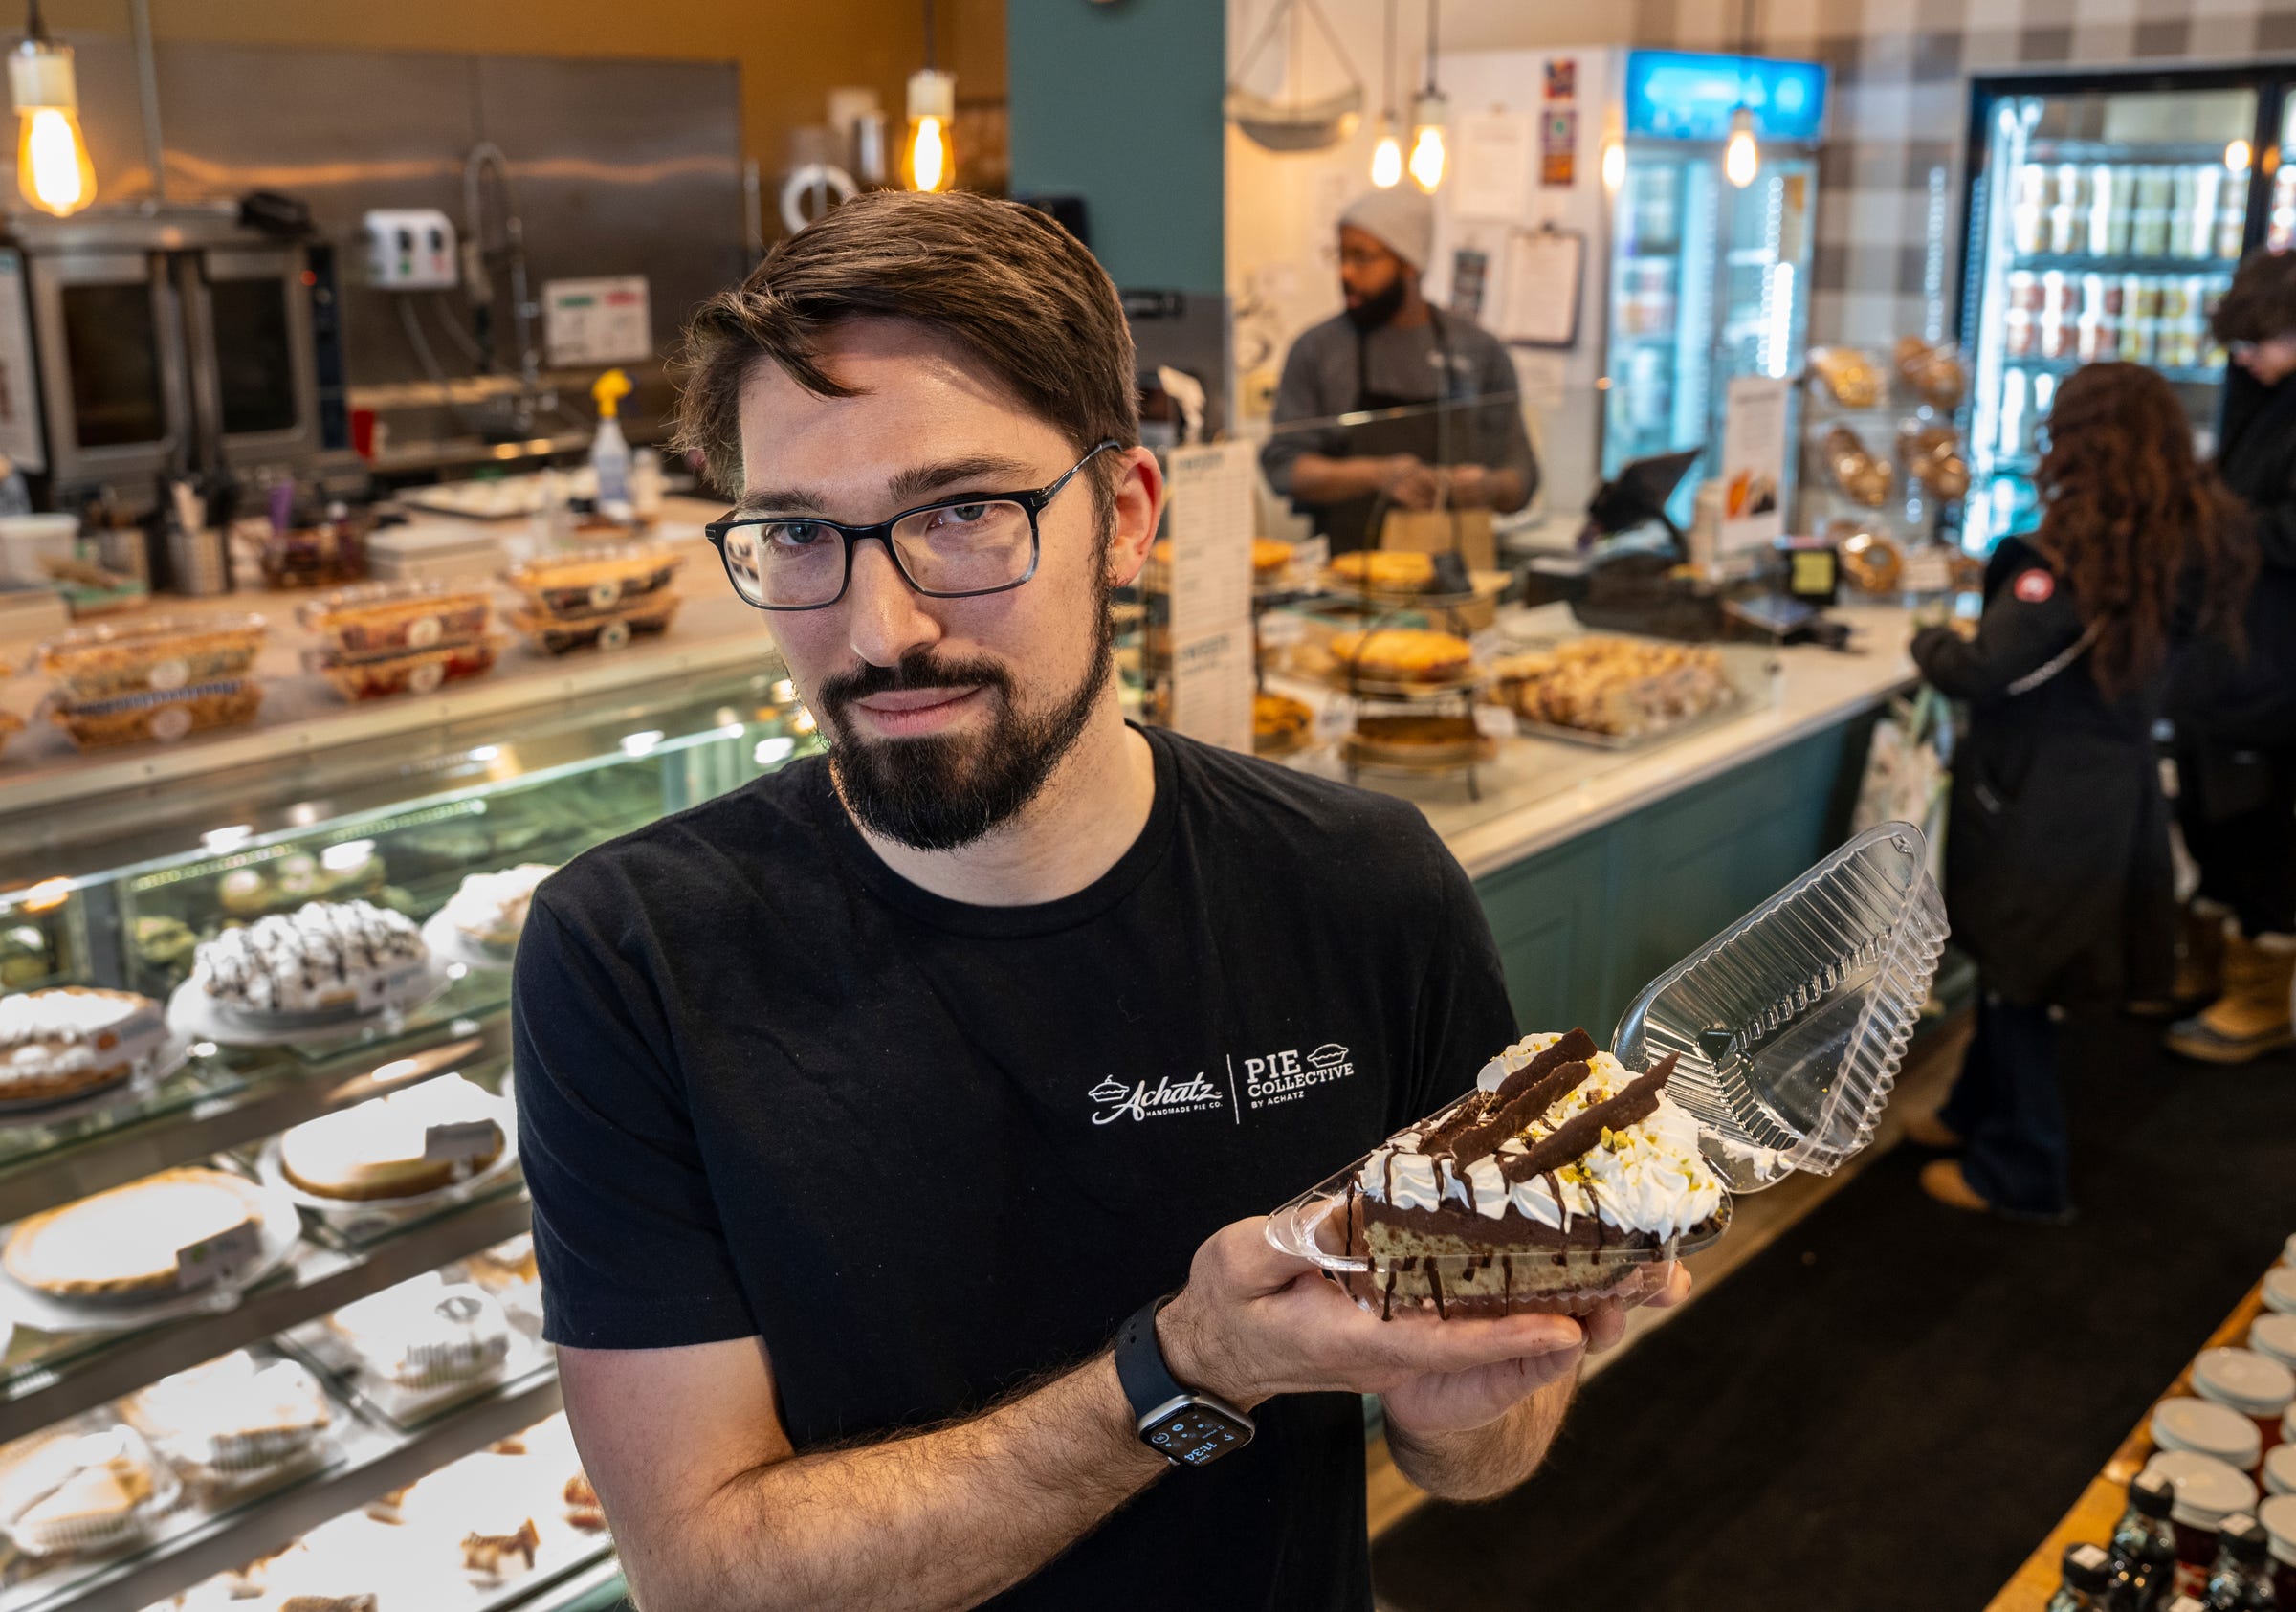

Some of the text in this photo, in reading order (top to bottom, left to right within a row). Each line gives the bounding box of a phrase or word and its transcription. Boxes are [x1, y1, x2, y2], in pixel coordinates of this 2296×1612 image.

[1244, 1049, 1301, 1084] PIE
[1247, 1062, 1354, 1097] COLLECTIVE
[1092, 1071, 1223, 1125] Achatz
[1146, 1105, 1191, 1117] HANDMADE
[1250, 1090, 1305, 1109] BY ACHATZ
[1184, 1441, 1218, 1461] 11:34
